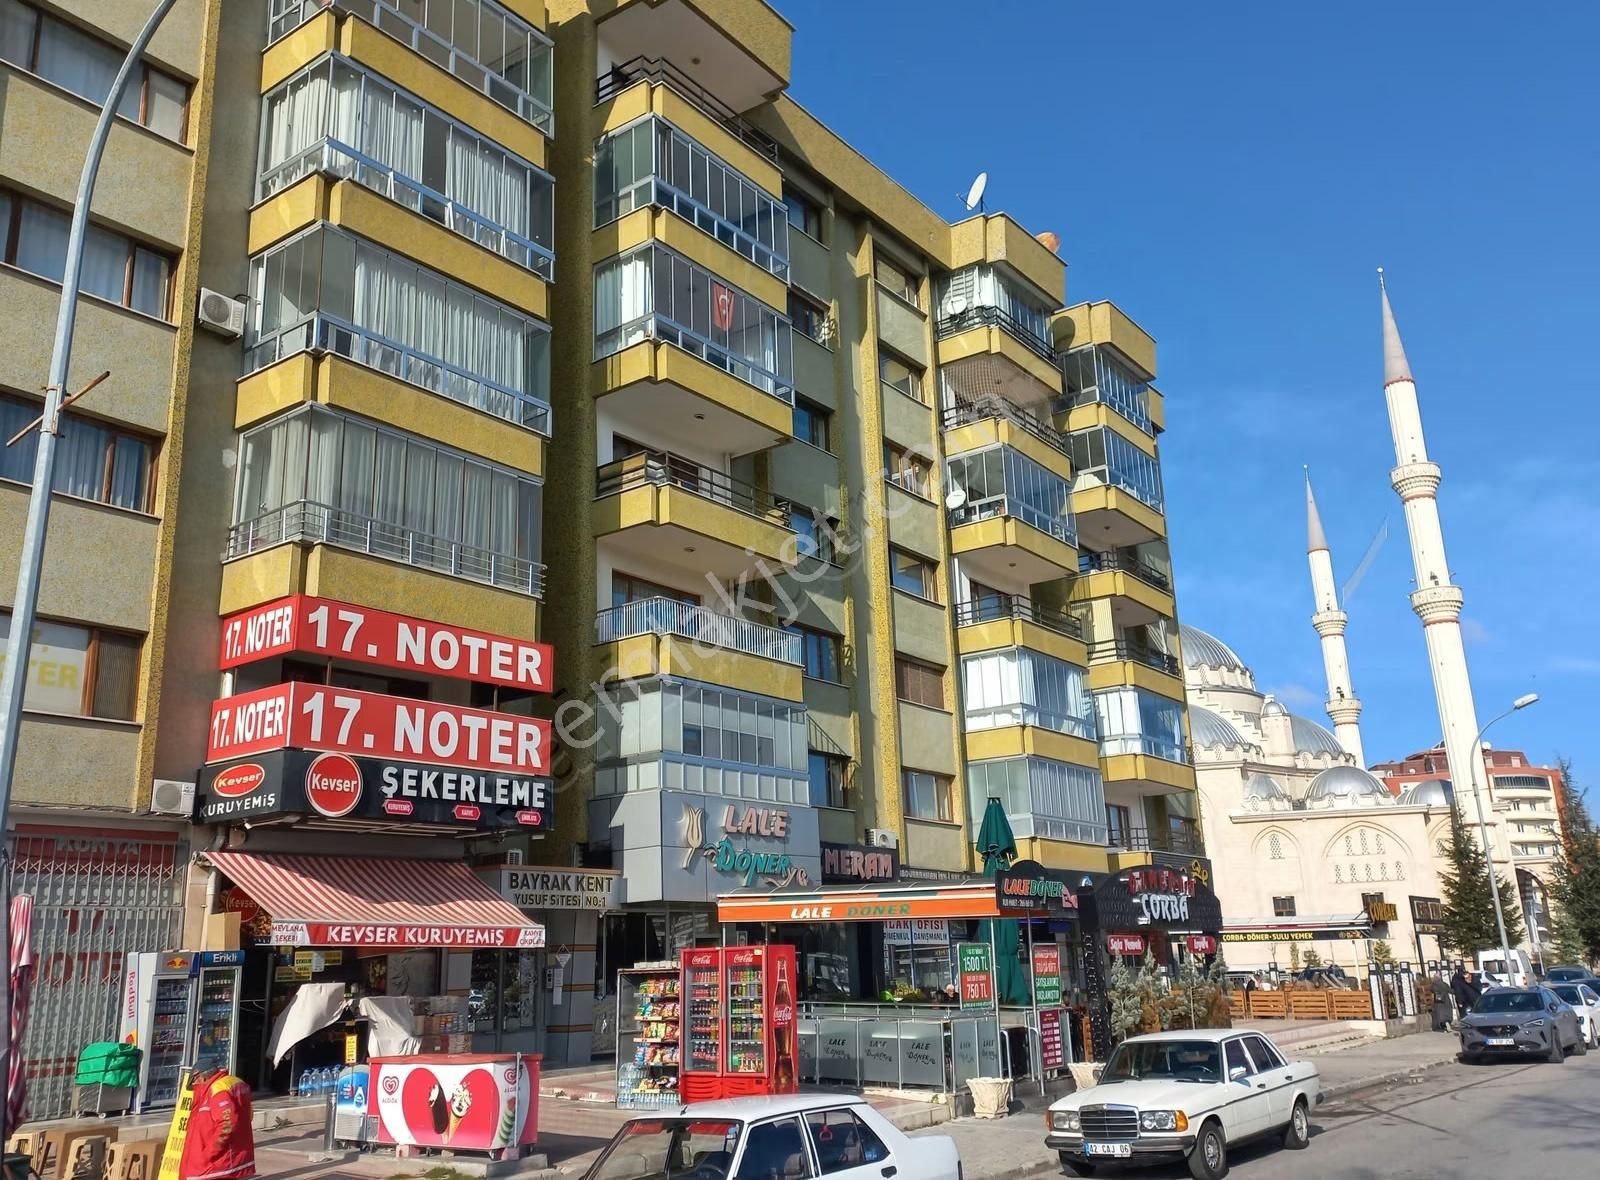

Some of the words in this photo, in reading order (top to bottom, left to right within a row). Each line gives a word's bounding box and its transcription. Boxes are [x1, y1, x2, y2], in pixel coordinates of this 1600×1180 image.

[225, 620, 242, 660] 17.
[245, 605, 293, 655] NOTER
[308, 605, 377, 658] 17.
[396, 622, 542, 686] NOTER
[213, 709, 230, 749] 17.
[233, 696, 285, 745] NOTER
[303, 692, 374, 749] 17.
[394, 704, 542, 768] NOTER
[217, 772, 262, 788] Kevser
[311, 773, 358, 793] Kevser
[381, 766, 545, 808] ŞEKERLEME
[724, 804, 789, 838] LALE
[714, 836, 791, 887] DÖNER
[824, 848, 893, 880] MERAM
[509, 872, 572, 892] BAYRAK
[575, 875, 614, 893] KENT
[1003, 878, 1030, 895] LALE
[515, 894, 549, 906] YUSUF
[790, 906, 832, 919] LALE
[327, 926, 398, 944] KEVSER
[1273, 932, 1289, 940] SULU
[1291, 932, 1313, 940] YEMEK
[213, 953, 238, 963] Erikli
[963, 956, 980, 971] 1500
[981, 956, 988, 971] TL
[967, 983, 980, 999] 750
[980, 983, 988, 998] TL
[829, 1038, 846, 1046] LALE
[1120, 1144, 1129, 1153] 06
